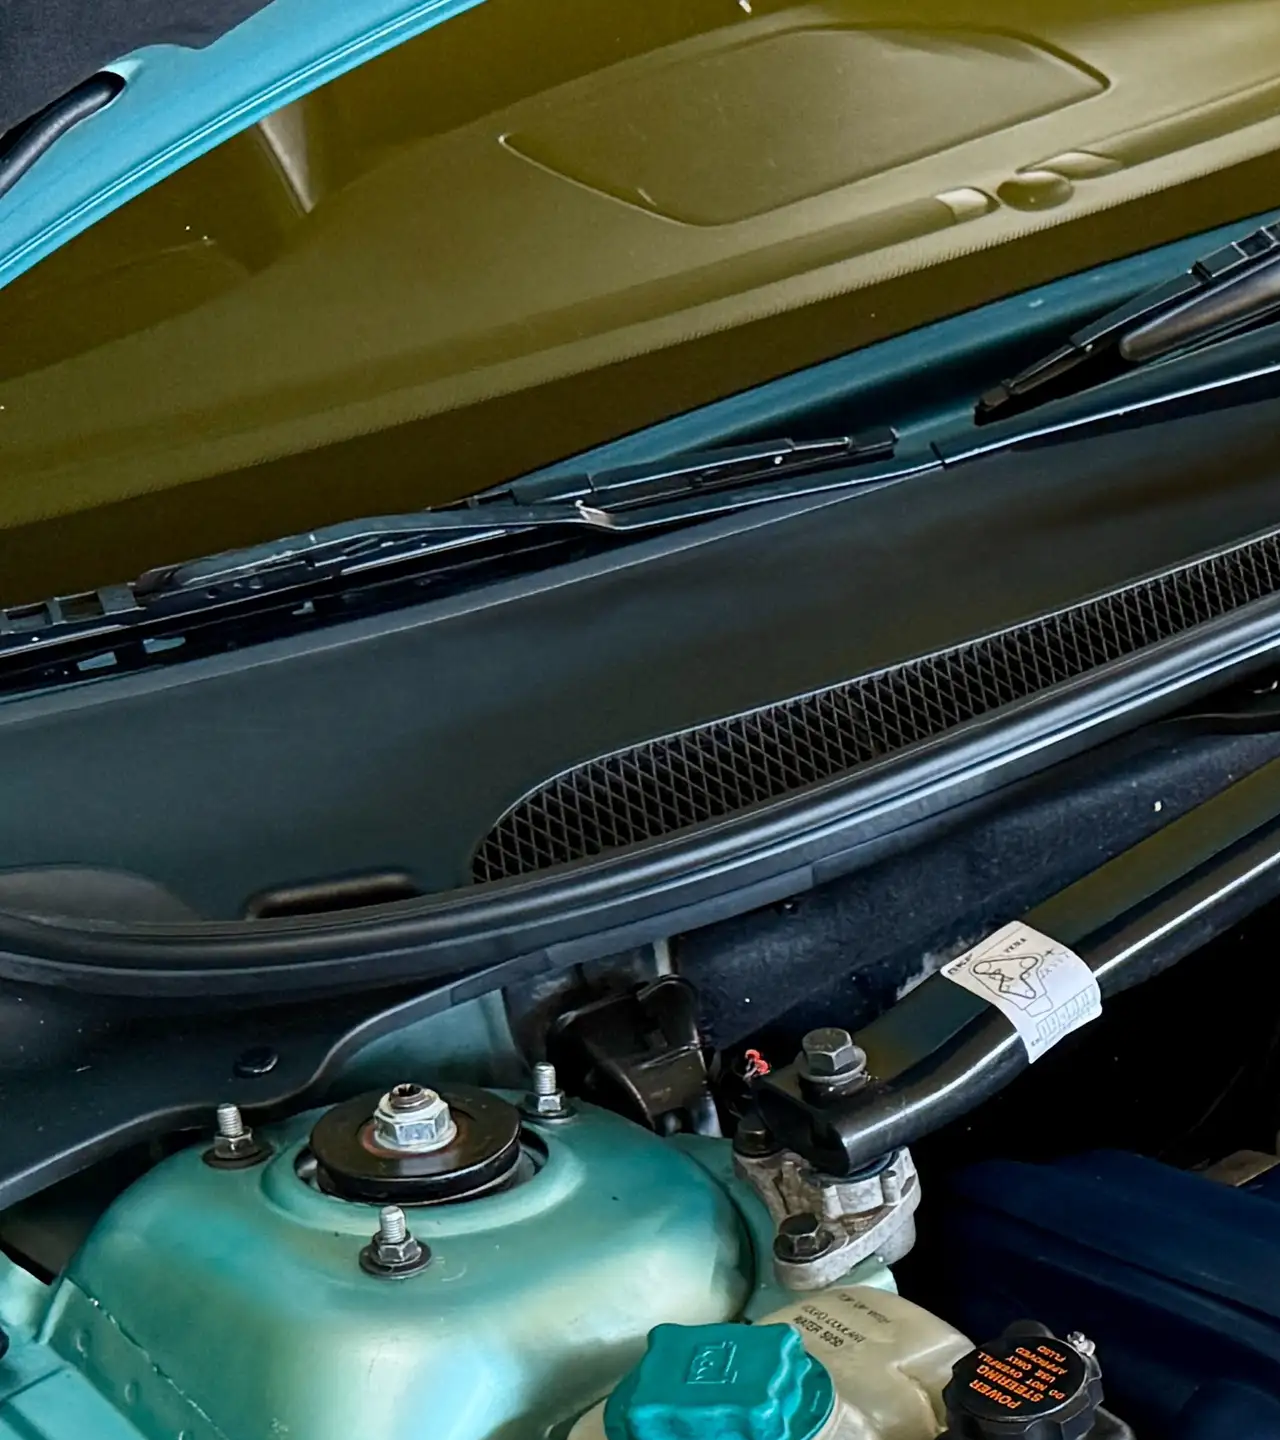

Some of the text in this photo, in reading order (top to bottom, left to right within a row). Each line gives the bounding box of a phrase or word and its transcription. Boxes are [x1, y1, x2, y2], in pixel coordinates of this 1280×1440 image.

[1015, 1347, 1068, 1375] APPROVED
[1037, 1345, 1067, 1363] FLUID
[978, 1352, 1066, 1400] DO NOT OVERFILL
[1005, 1355, 1056, 1383] USE ONLY
[968, 1379, 1022, 1409] POWER
[976, 1365, 1044, 1403] STEERING
